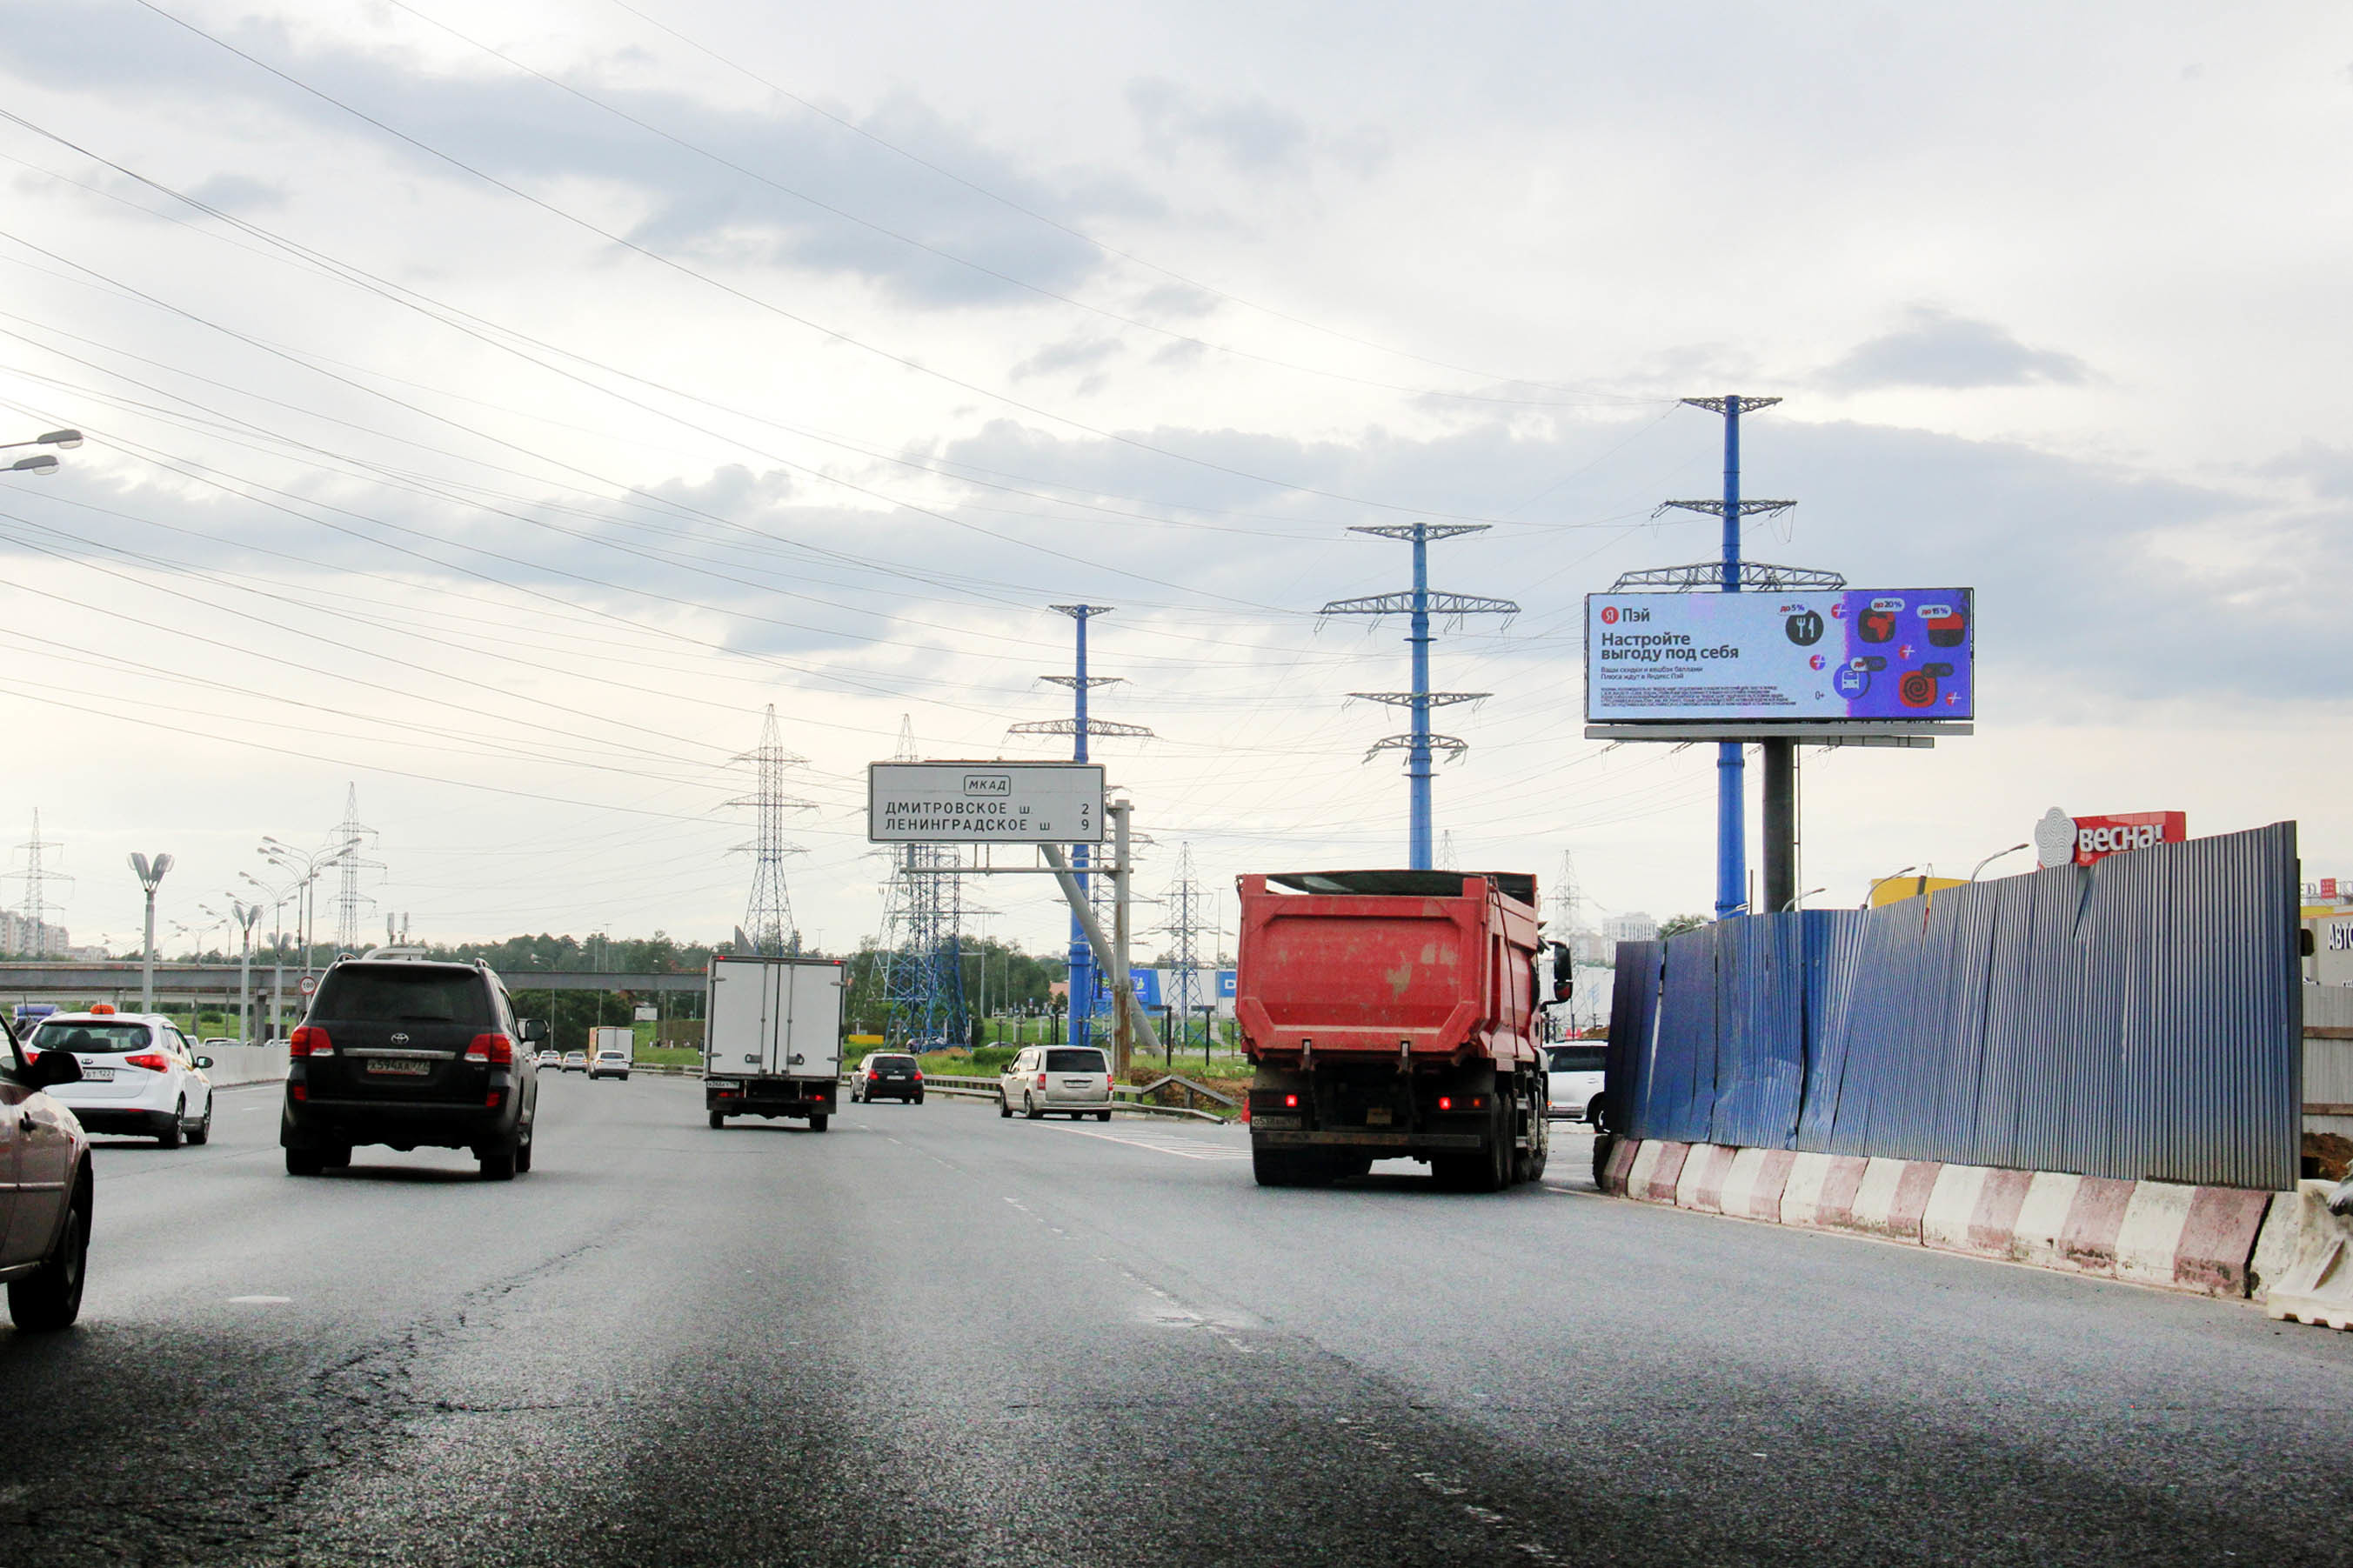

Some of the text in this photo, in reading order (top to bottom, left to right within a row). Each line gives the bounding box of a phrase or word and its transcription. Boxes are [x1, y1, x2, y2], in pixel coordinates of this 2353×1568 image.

[1622, 607, 1650, 623] Пэй
[1601, 631, 1691, 649] Настройте
[1601, 644, 1739, 662] выгоду под себя
[1815, 691, 1825, 700] 0+
[968, 780, 1007, 791] МКАД
[885, 802, 1007, 816] ДМИТРОВСКОЕ
[1081, 804, 1089, 815] 2
[885, 818, 1027, 832] ЛЕНИНГРАДСКОЕ
[1081, 820, 1088, 831] 9
